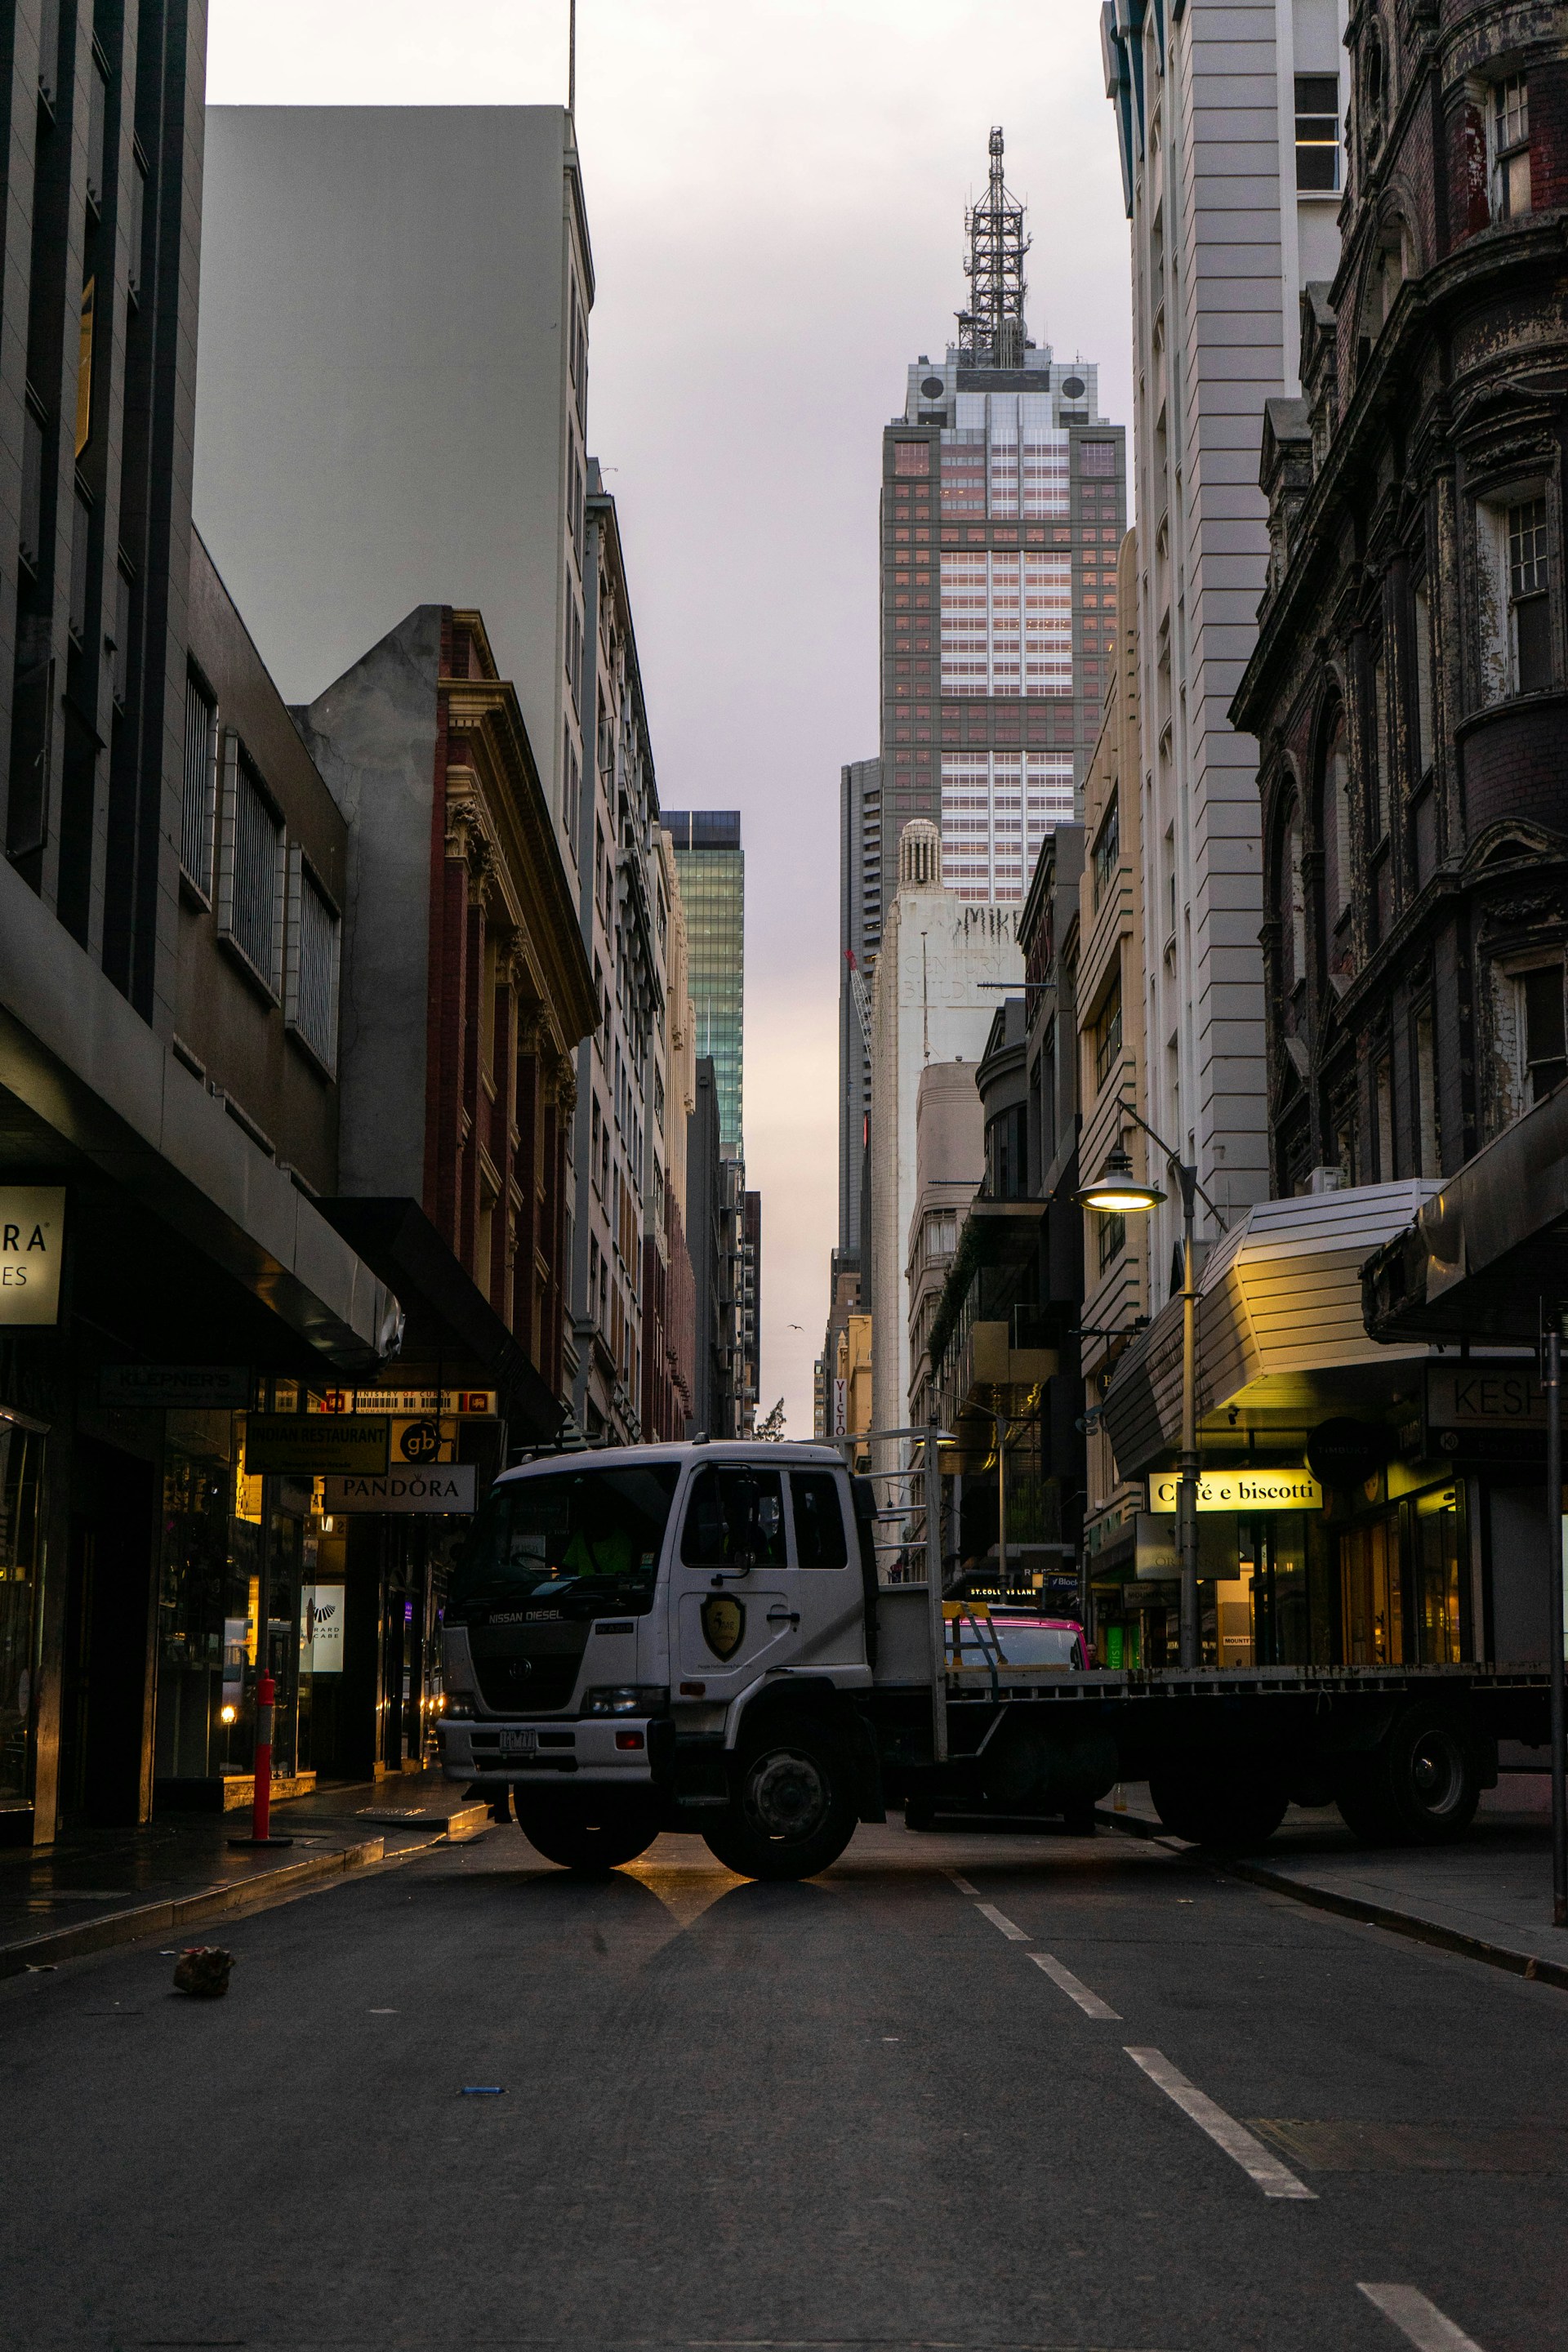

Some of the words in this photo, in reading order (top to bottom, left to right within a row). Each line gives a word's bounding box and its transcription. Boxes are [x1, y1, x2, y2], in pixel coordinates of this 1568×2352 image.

[905, 956, 1005, 973] CENTURY
[903, 981, 1004, 999] BUILDING
[2, 1267, 28, 1285] ES
[120, 1373, 231, 1387] KLEPNER'S
[252, 1427, 298, 1442] INDIAN
[301, 1428, 385, 1443] RESTAURANT
[408, 1429, 434, 1455] gb
[343, 1479, 459, 1497] PANDORA
[1158, 1483, 1213, 1502] Cfé
[1220, 1487, 1232, 1499] e
[1238, 1480, 1314, 1500] biscotti
[488, 1612, 523, 1624] NISSAN
[525, 1610, 564, 1621] DIESEL
